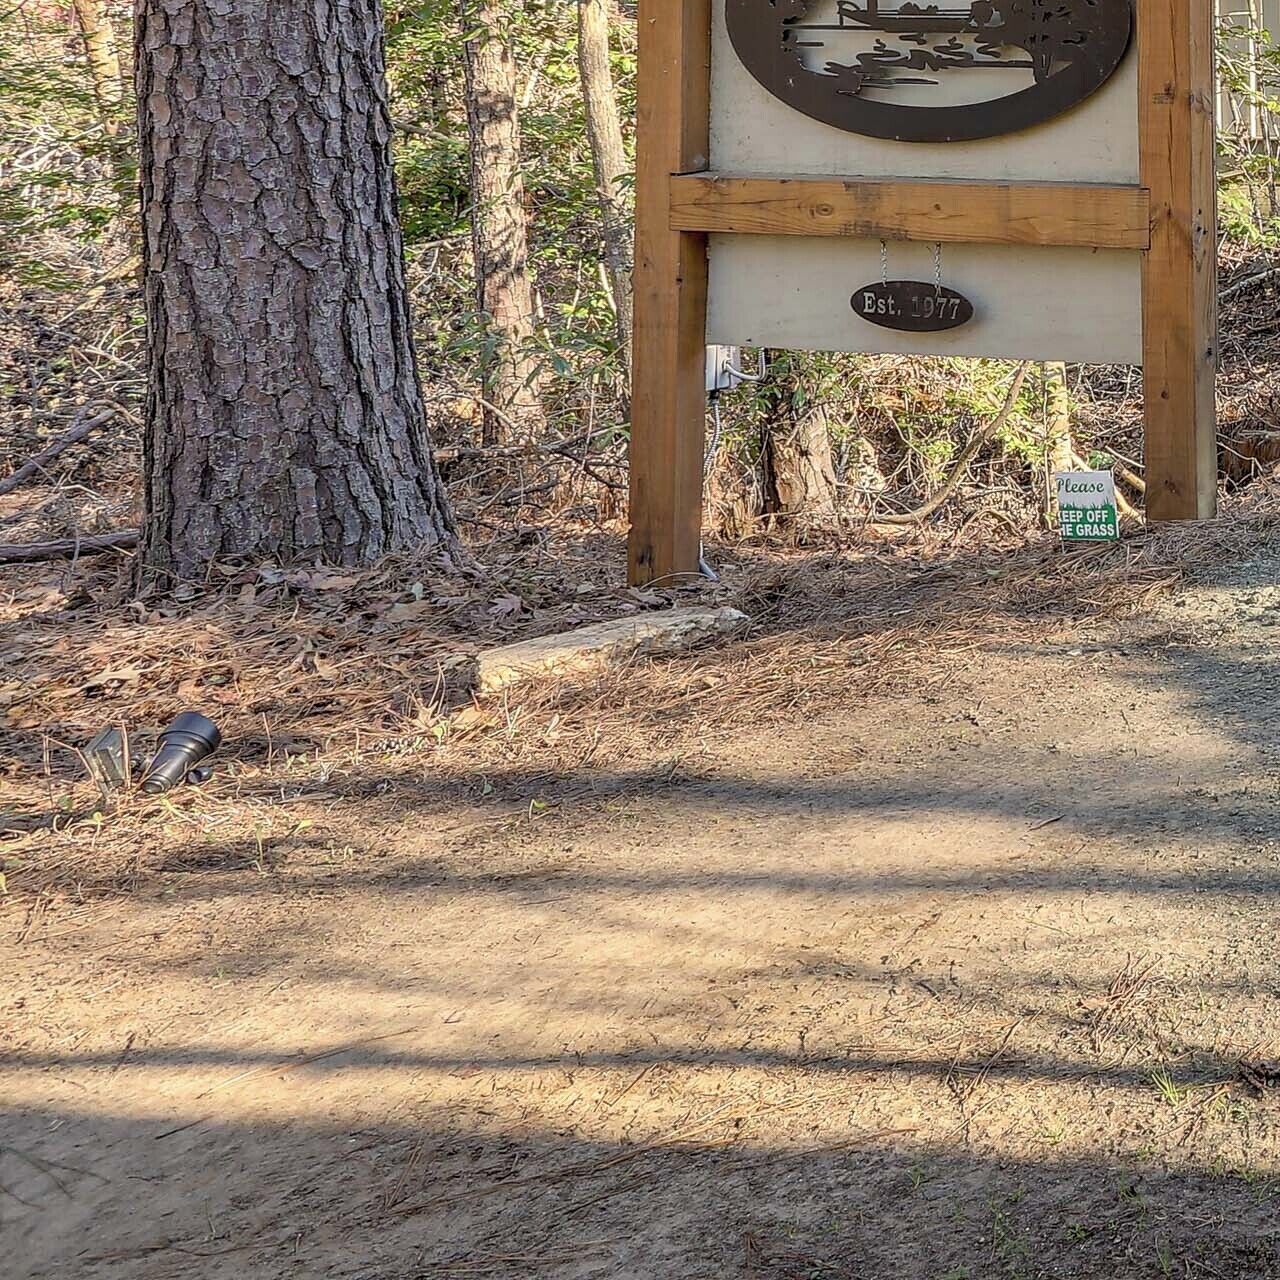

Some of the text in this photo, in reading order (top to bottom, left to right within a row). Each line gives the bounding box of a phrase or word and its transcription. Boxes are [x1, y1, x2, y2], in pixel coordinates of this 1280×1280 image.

[863, 292, 961, 319] Est. 1977
[1056, 477, 1104, 493] Please
[1086, 510, 1108, 522] OFF
[1060, 524, 1115, 537] HE GRASS
